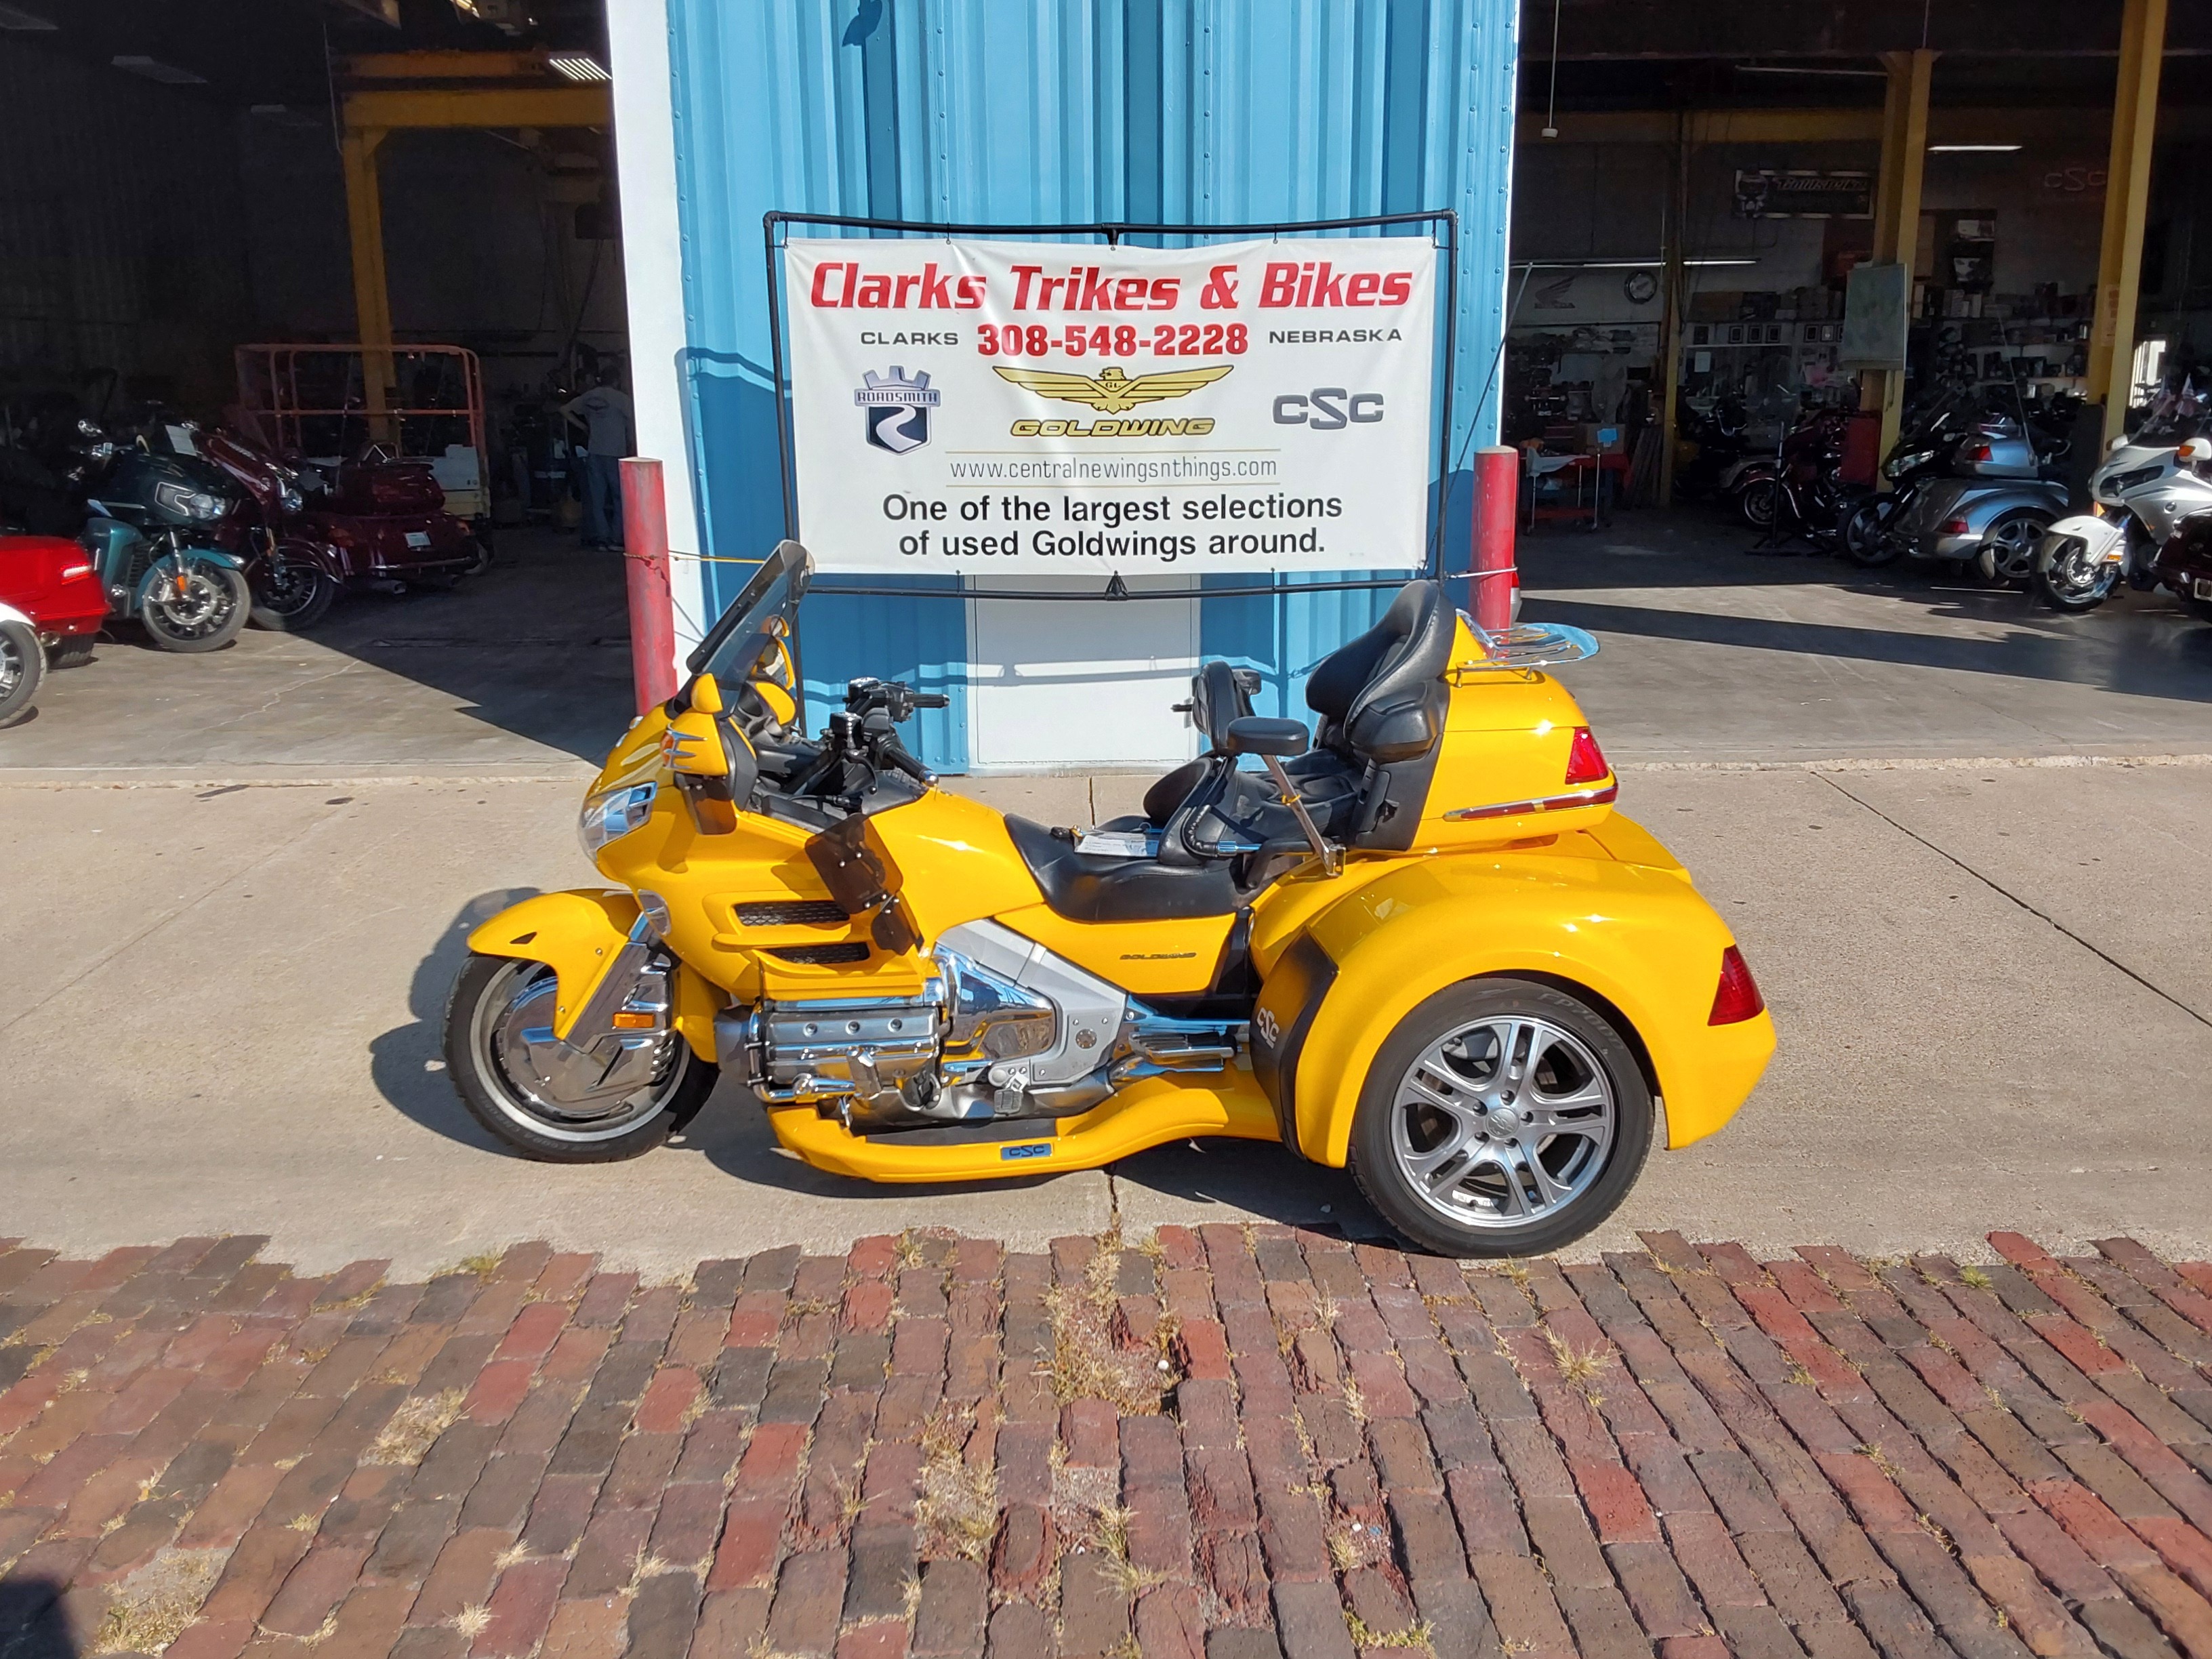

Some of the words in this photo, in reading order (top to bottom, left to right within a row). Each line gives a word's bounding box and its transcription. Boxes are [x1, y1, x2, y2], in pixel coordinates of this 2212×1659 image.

[811, 262, 987, 309] Clarks
[1010, 264, 1181, 311] Trikes
[1200, 264, 1239, 310] &
[1258, 262, 1413, 308] Bikes
[861, 332, 958, 345] CLARKS
[978, 323, 1248, 357] 308-548-2228
[1269, 329, 1401, 344] NEBRASKA
[857, 391, 937, 403] ROADSMITH
[1010, 417, 1216, 438] GOLDWING
[950, 457, 1276, 483] www.centralnewingsnthings.com
[884, 494, 947, 520] One
[960, 495, 990, 520] of
[1001, 496, 1050, 521] the
[1064, 496, 1170, 529] largest
[1183, 493, 1342, 520] selections
[899, 530, 930, 555] of
[943, 531, 1019, 556] used
[1032, 530, 1196, 562] Goldwings
[1209, 527, 1324, 554] around.
